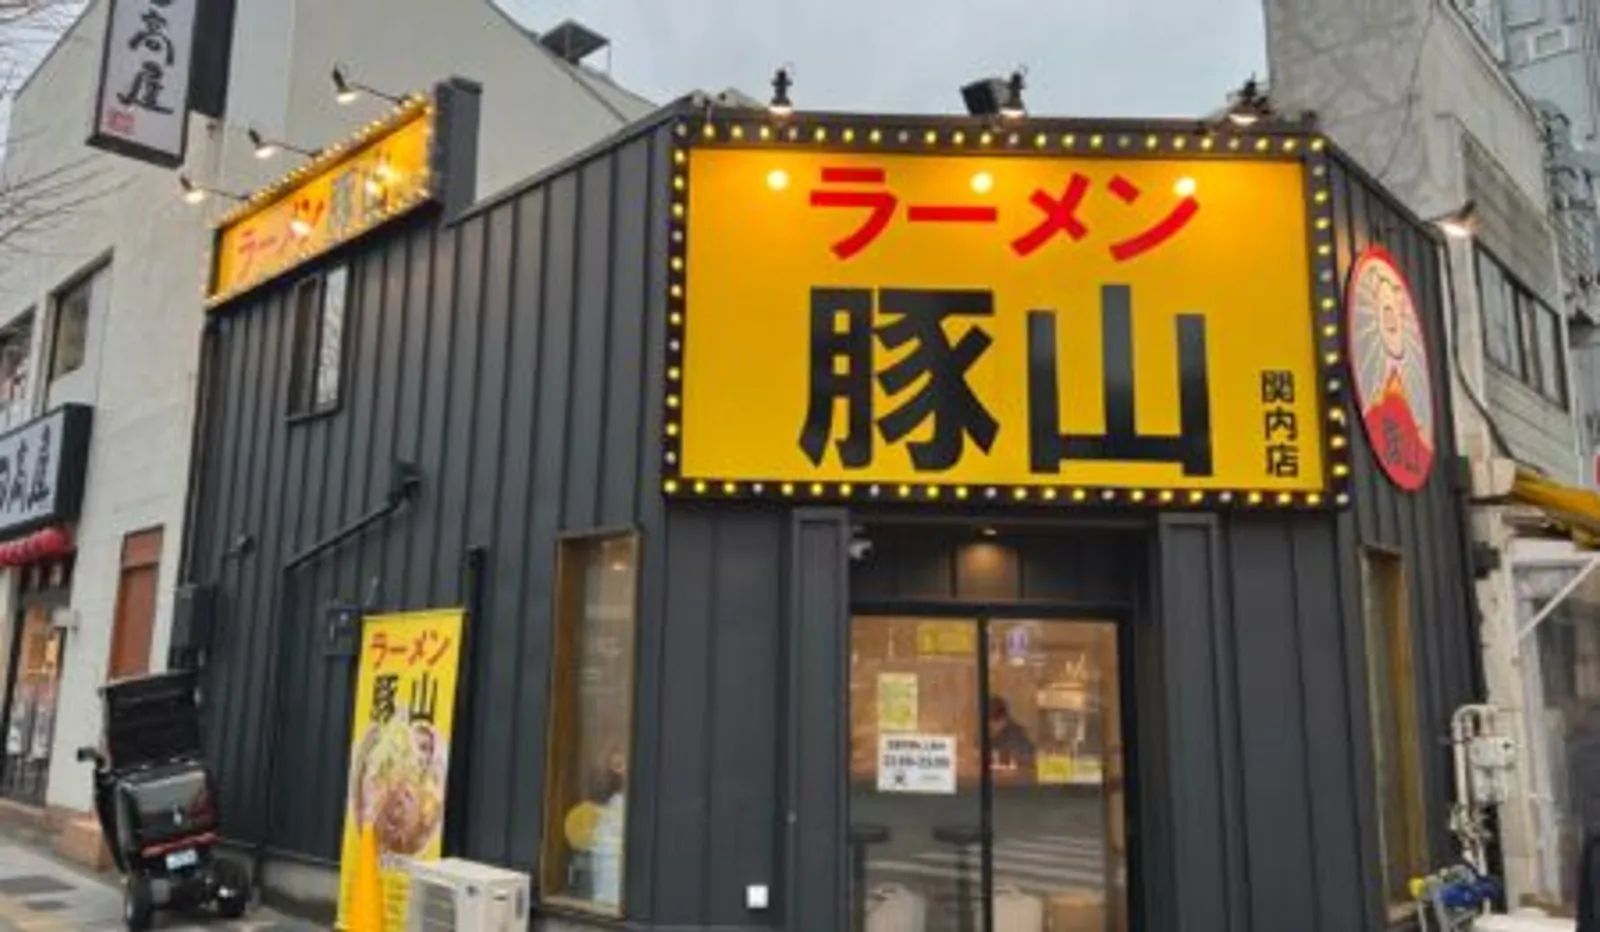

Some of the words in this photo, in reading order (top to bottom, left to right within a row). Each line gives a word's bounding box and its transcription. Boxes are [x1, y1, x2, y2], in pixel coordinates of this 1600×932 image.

[115, 0, 175, 115] 高屋
[809, 166, 1199, 262] ラーメン
[798, 284, 1213, 477] 豚山
[1261, 369, 1299, 478] 関内店
[369, 629, 450, 669] ラーメン
[369, 671, 438, 725] 豚山
